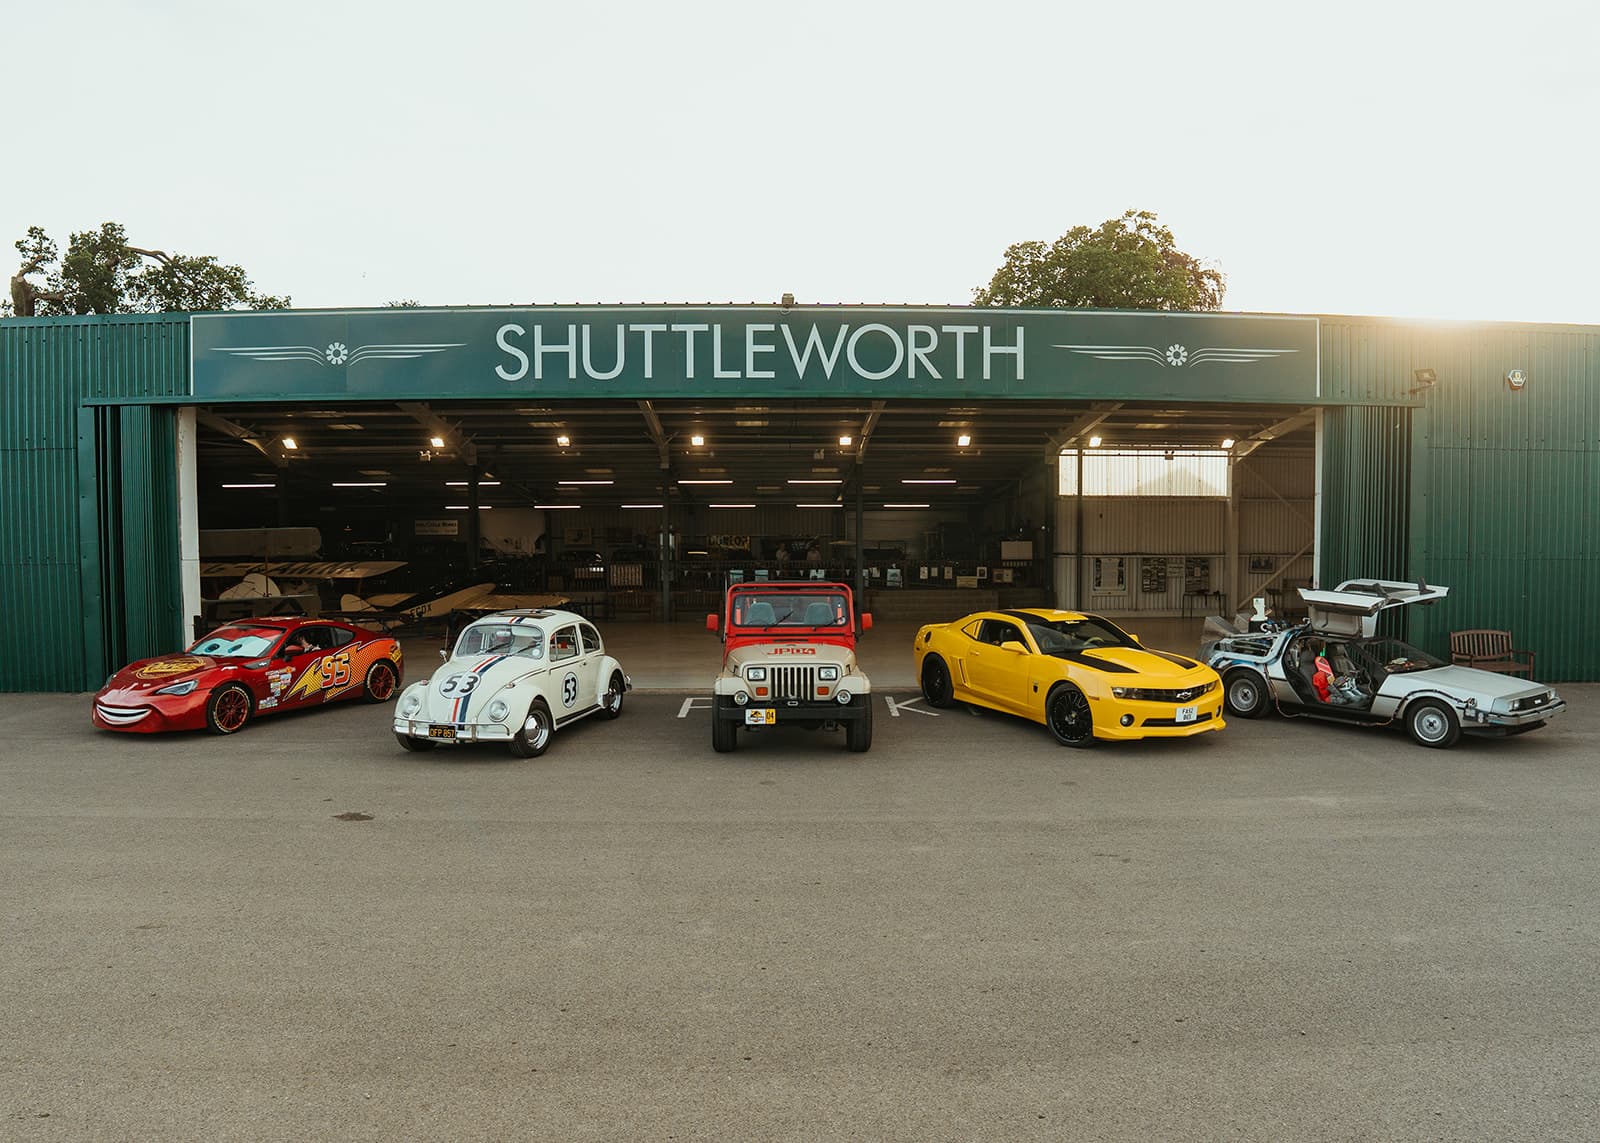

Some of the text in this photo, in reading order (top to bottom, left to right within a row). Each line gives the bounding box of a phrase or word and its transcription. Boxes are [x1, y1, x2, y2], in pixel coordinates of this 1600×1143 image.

[495, 323, 1025, 381] SHUTTLEWORTH
[321, 653, 350, 688] 95
[442, 675, 479, 693] 53
[563, 677, 577, 703] 53
[766, 711, 775, 721] 04
